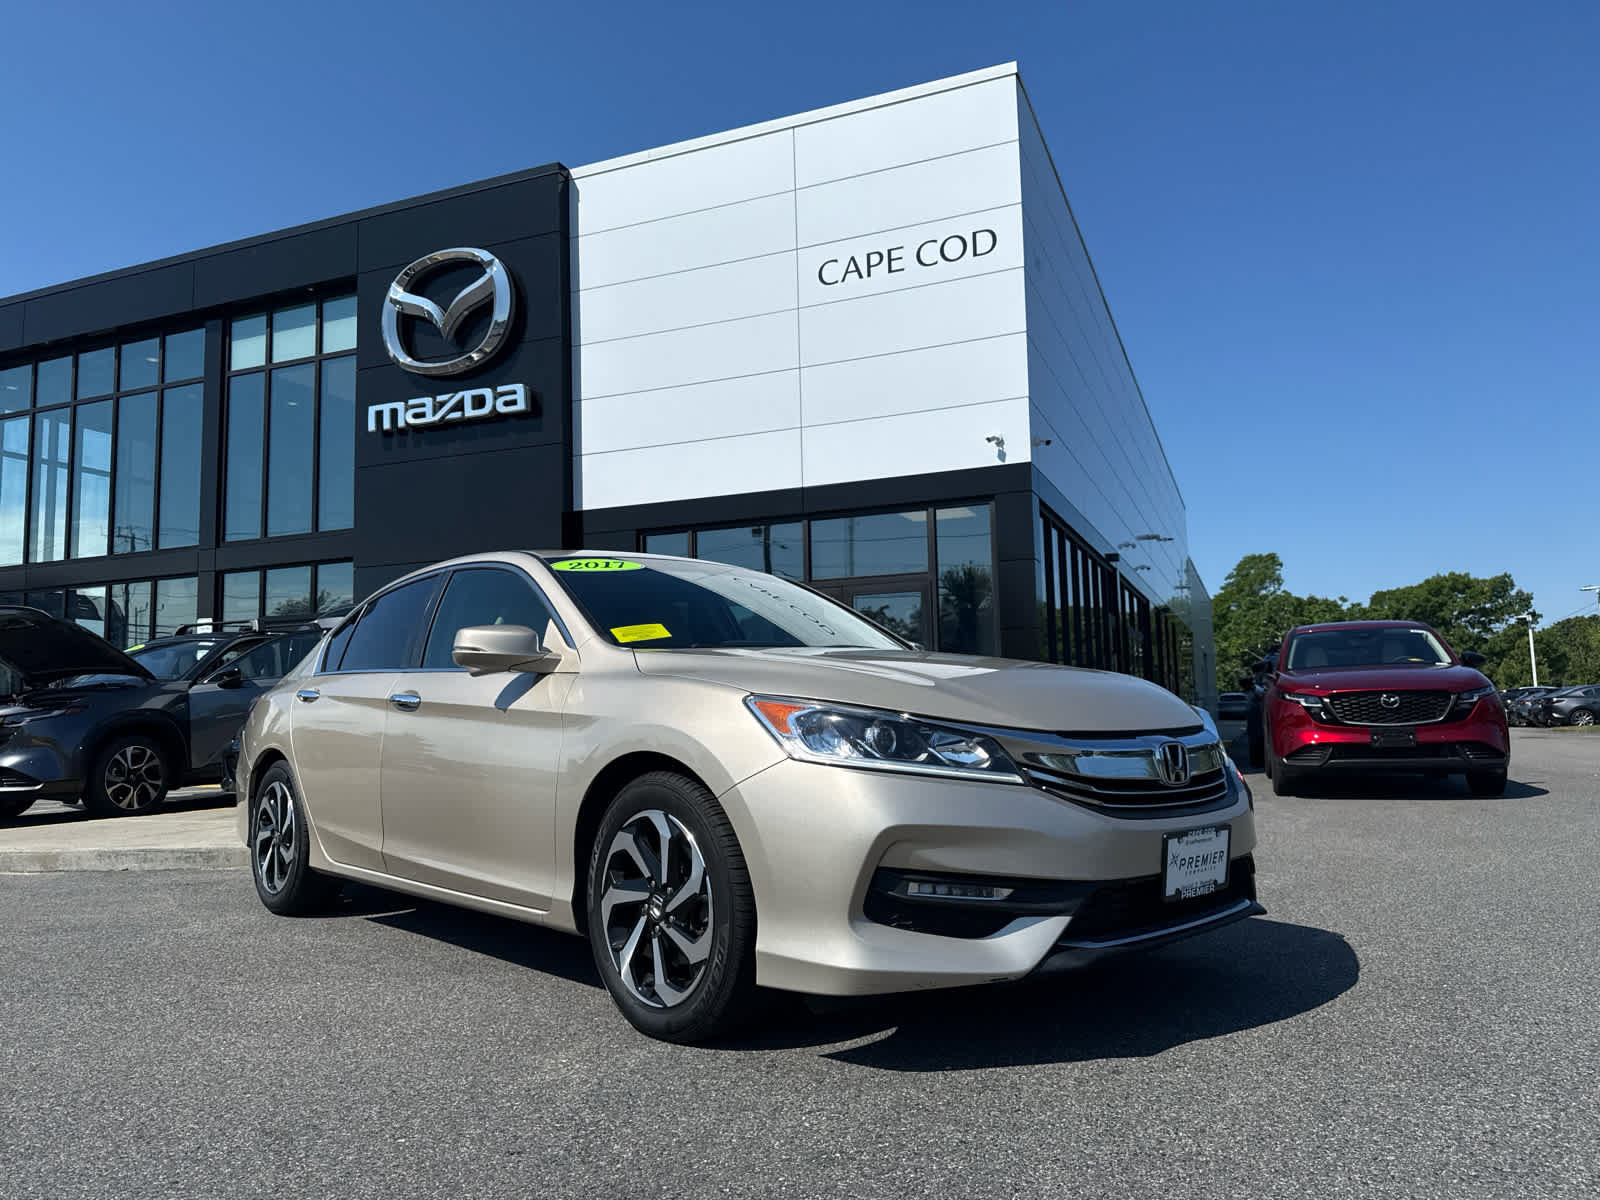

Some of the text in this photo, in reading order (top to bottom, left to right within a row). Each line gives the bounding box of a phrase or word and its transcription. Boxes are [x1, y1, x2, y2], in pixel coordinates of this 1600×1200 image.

[818, 228, 998, 286] CAPE COD
[568, 561, 625, 570] 2017
[1178, 850, 1225, 871] PREMIER
[1180, 883, 1215, 900] PREMIER
